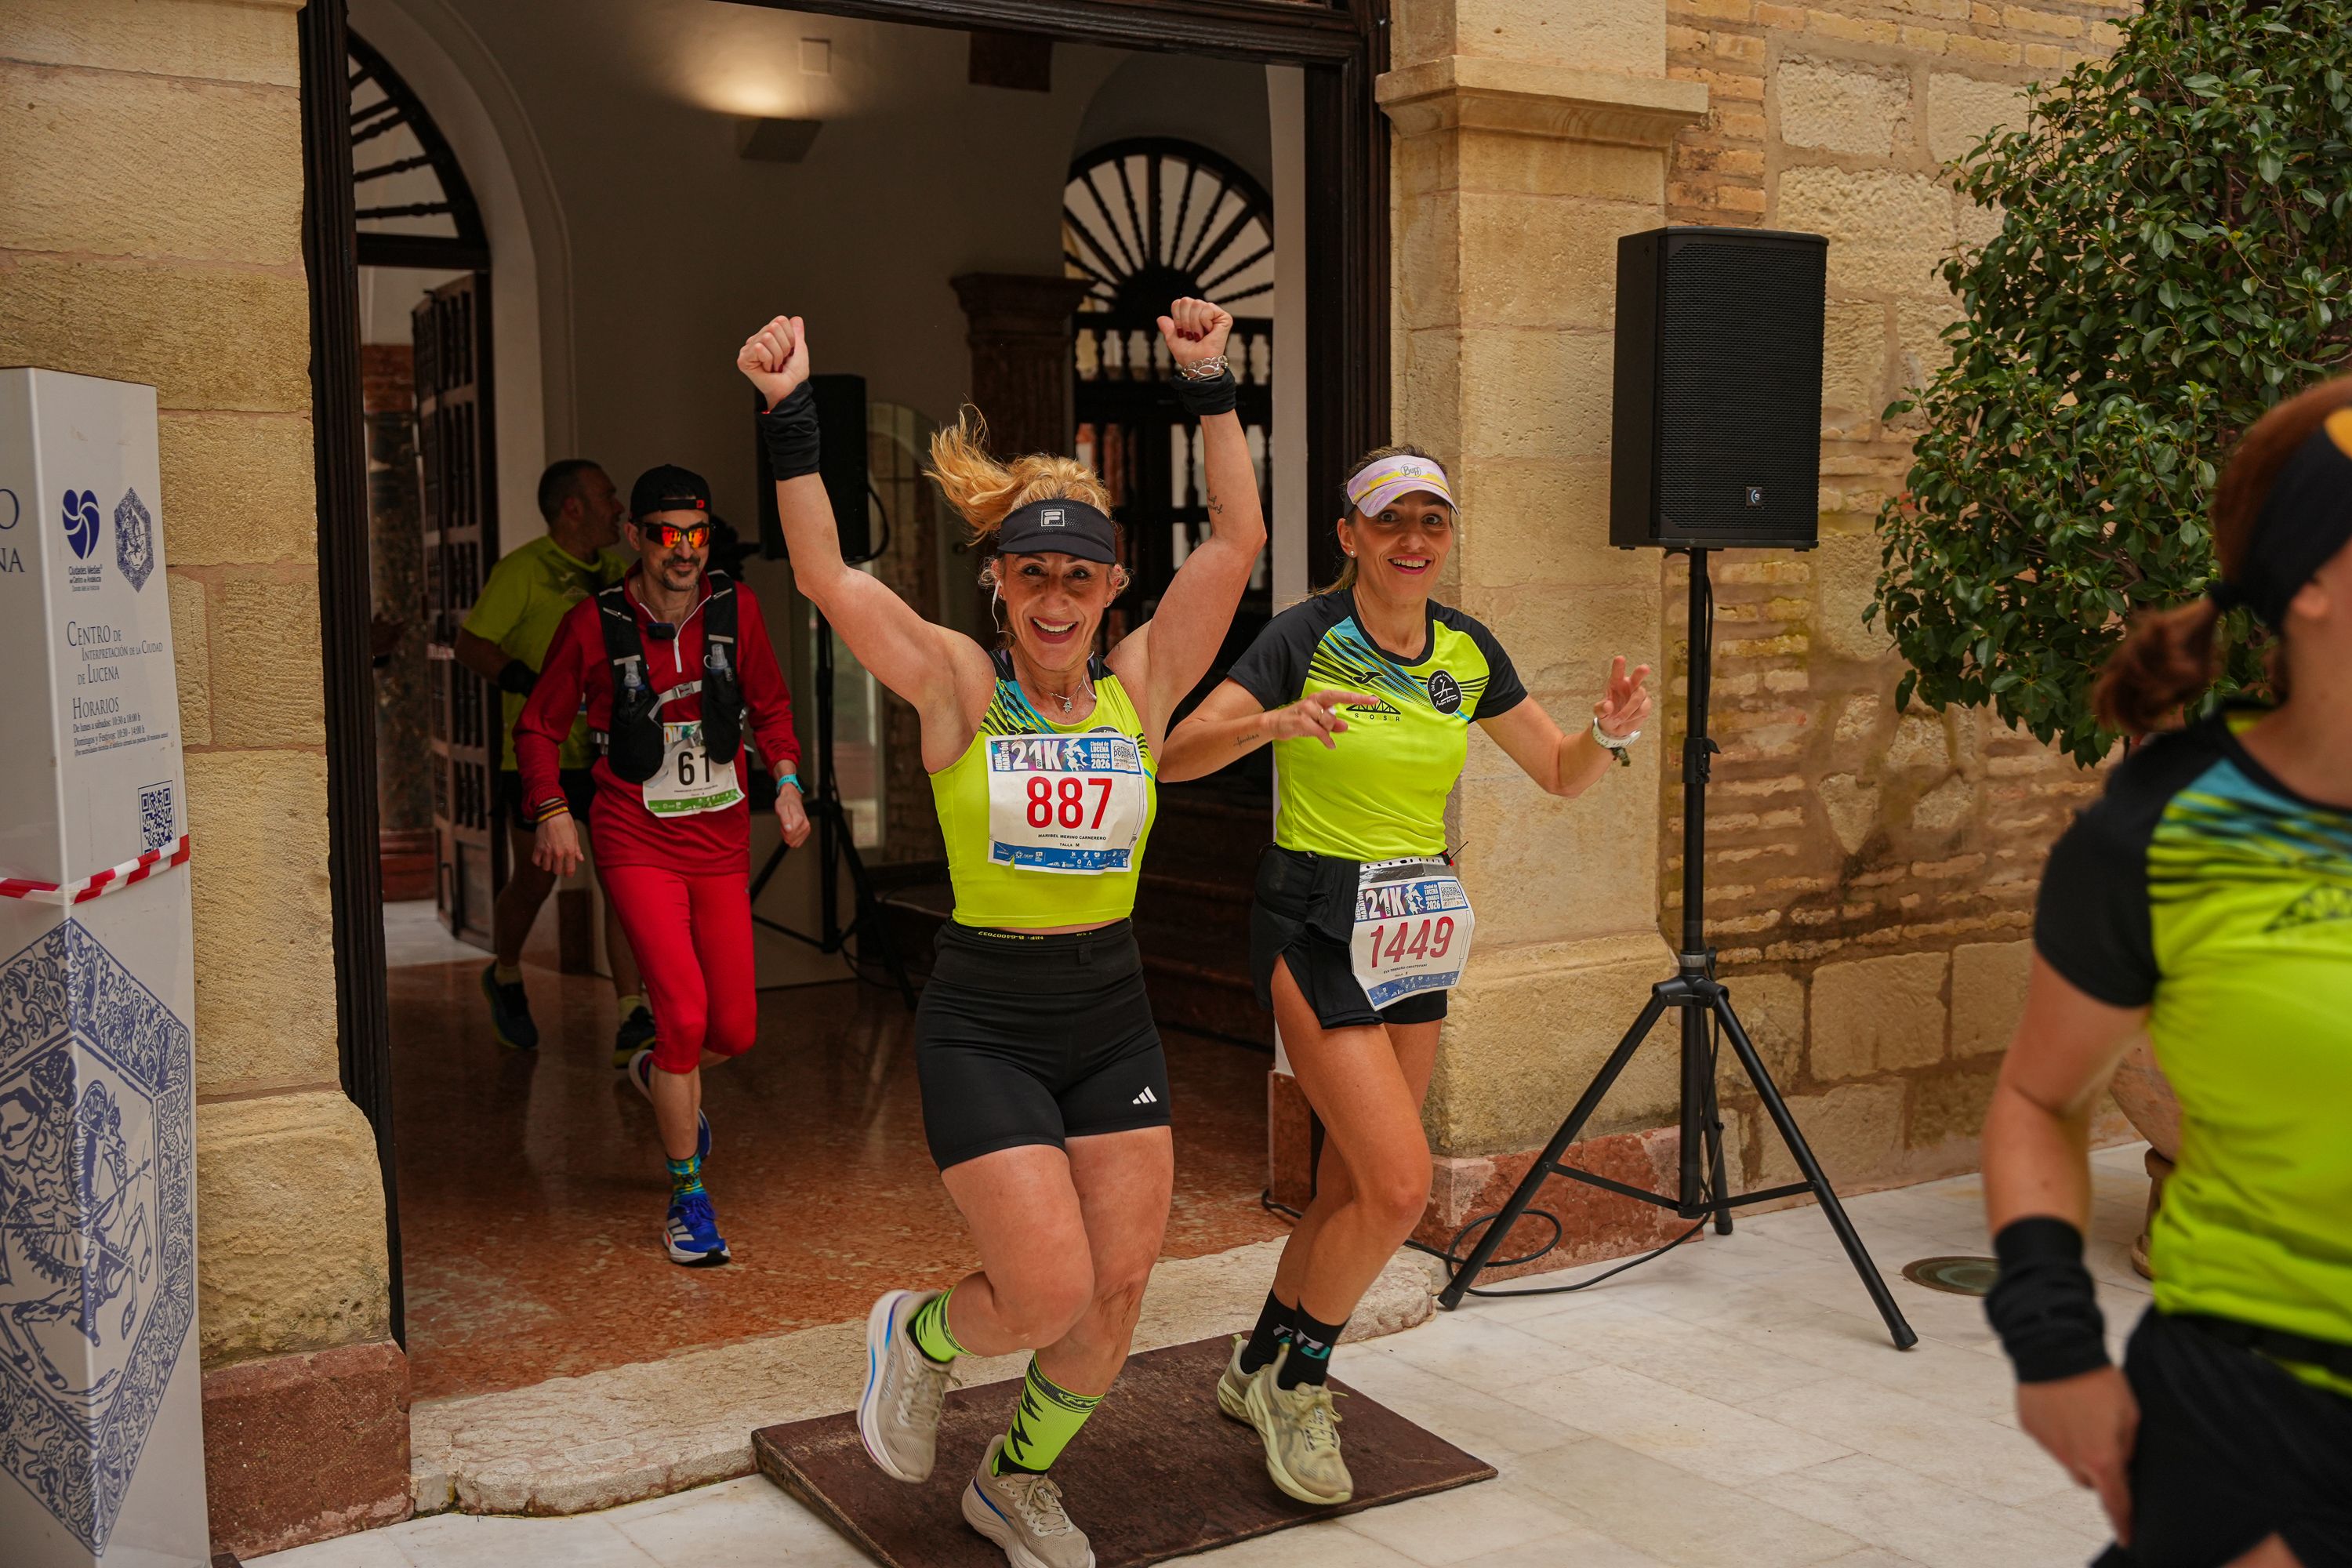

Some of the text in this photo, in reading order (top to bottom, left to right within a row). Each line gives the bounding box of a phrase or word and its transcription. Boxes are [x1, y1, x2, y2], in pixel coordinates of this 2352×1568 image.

[1403, 466, 1419, 476] Buff
[113, 630, 122, 641] DE
[78, 663, 120, 684] DE LUCENA
[72, 696, 119, 719] HORARIOS
[1011, 740, 1062, 771] 21K
[1091, 759, 1111, 769] 2026
[677, 751, 710, 786] 61
[1026, 775, 1112, 829] 887
[1366, 887, 1406, 918] 21K
[1425, 900, 1441, 910] 2026
[1370, 916, 1454, 968] 1449
